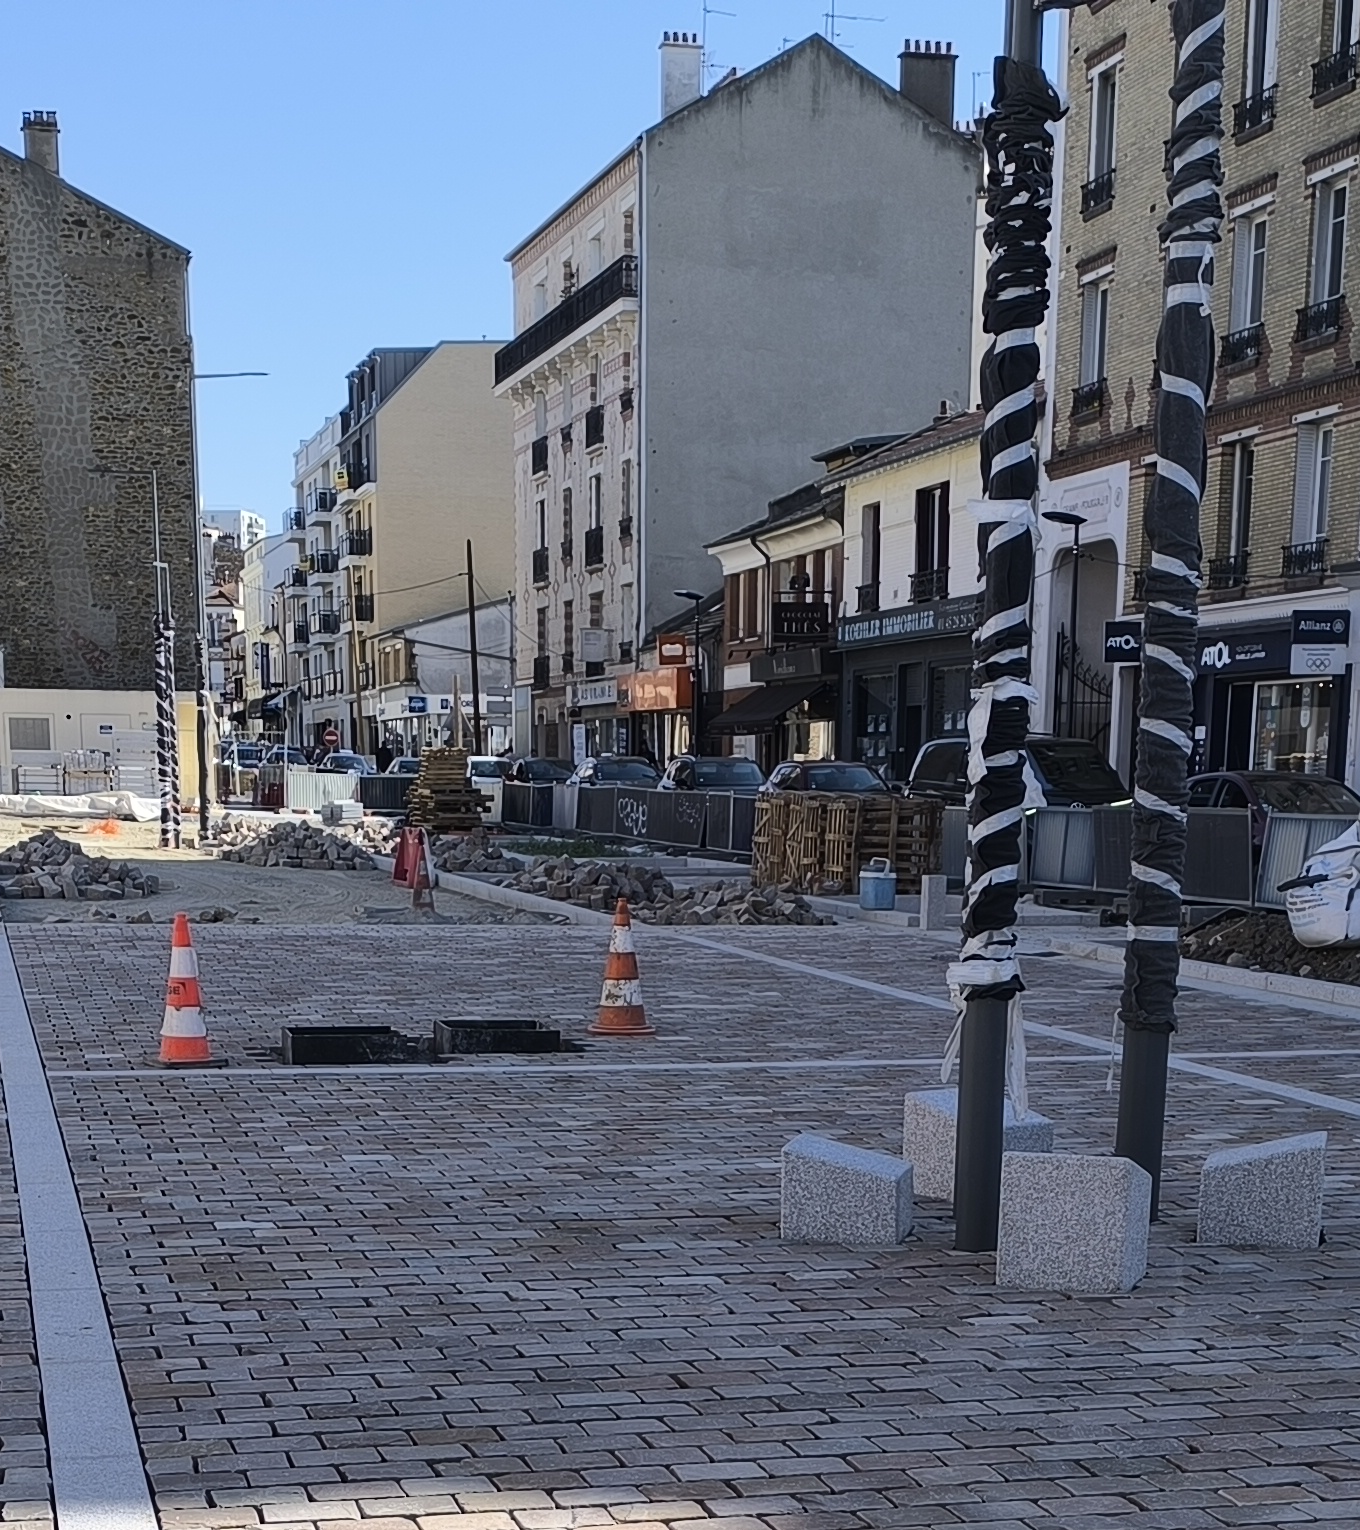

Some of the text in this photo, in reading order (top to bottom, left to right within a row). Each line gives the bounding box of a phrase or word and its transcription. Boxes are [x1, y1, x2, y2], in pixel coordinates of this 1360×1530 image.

[882, 610, 935, 636] IMMOBILIER
[1298, 620, 1331, 631] Allianz
[1200, 641, 1232, 669] ATOL
